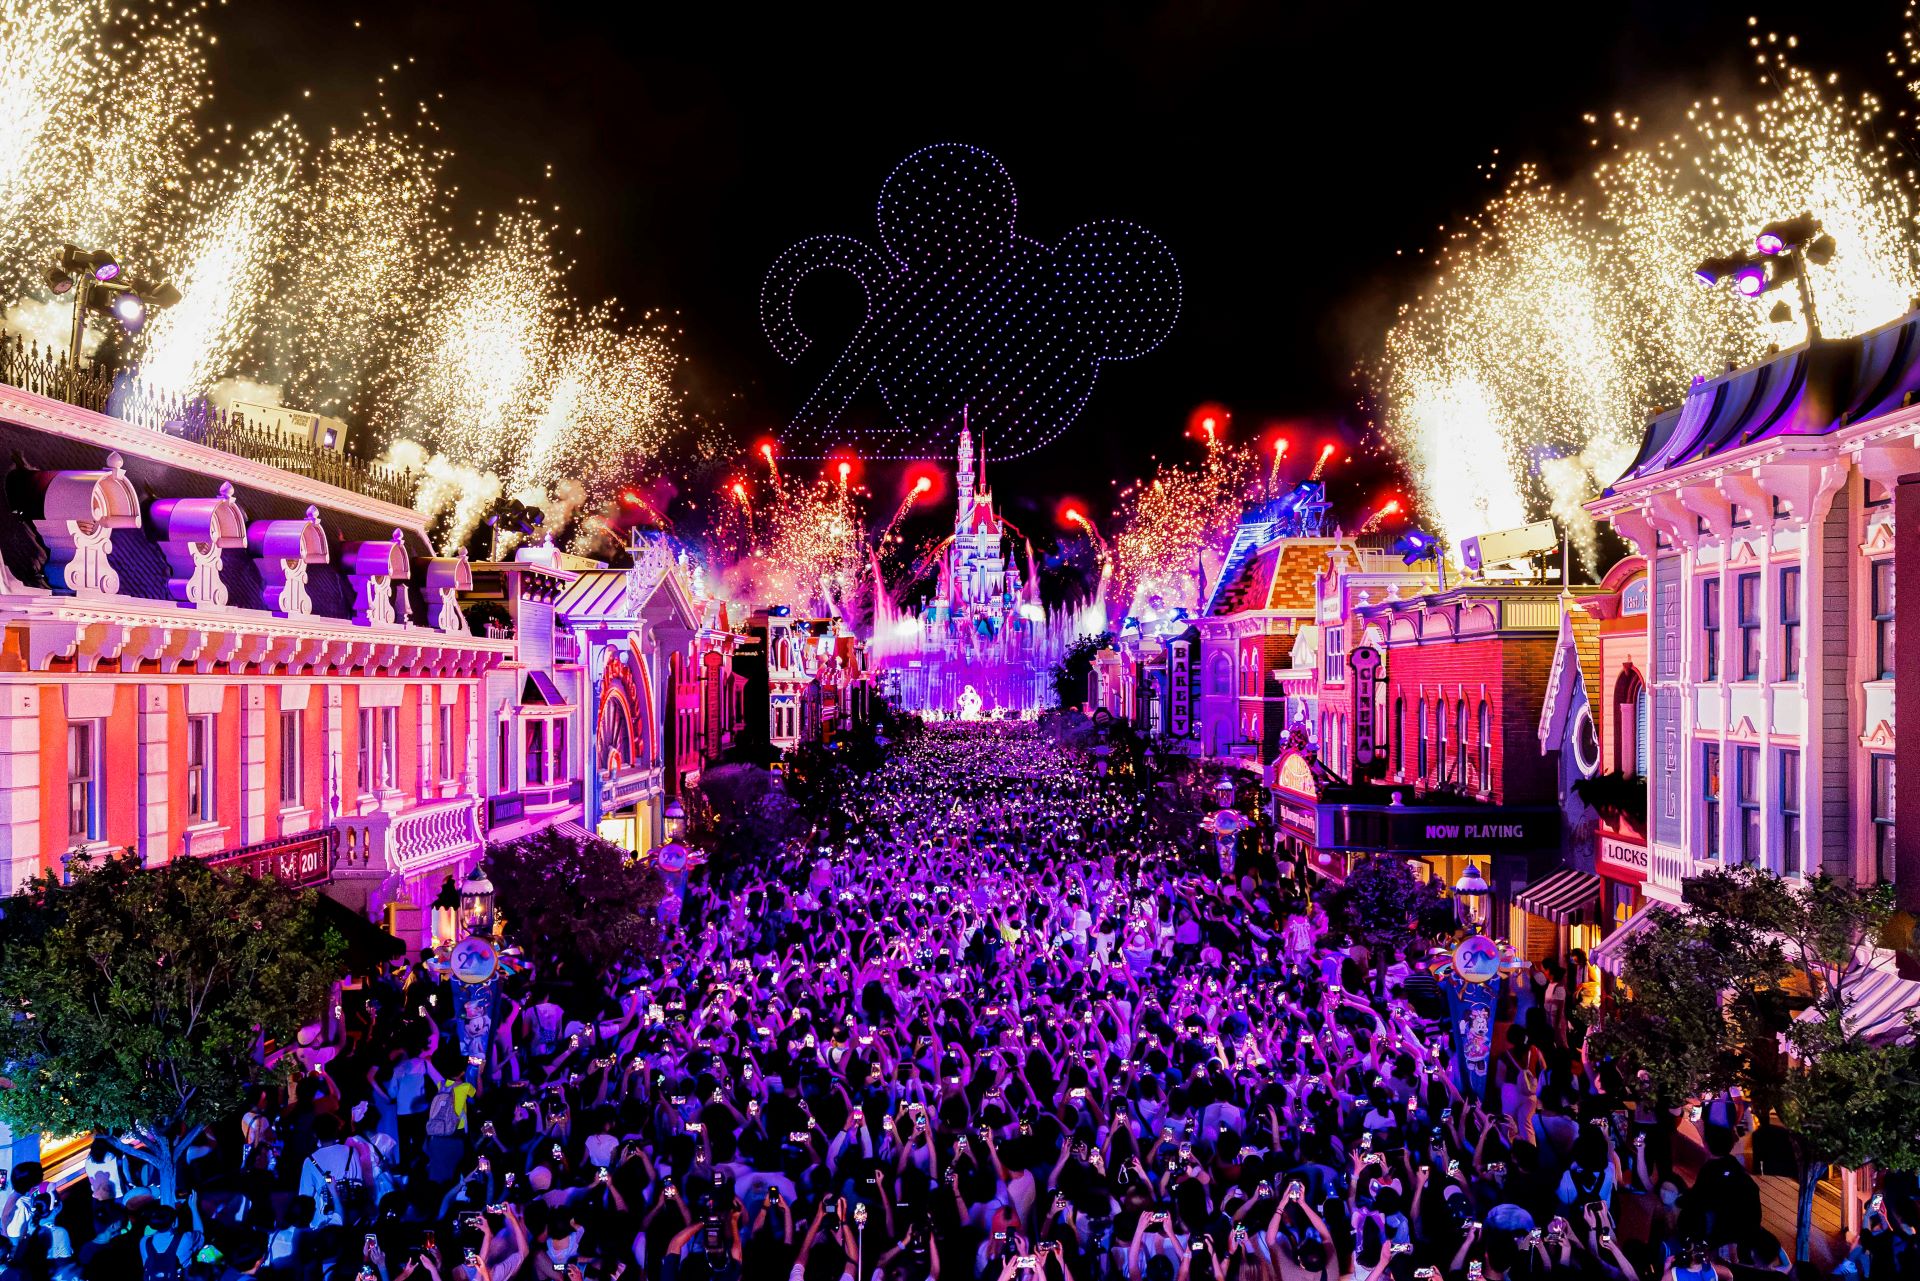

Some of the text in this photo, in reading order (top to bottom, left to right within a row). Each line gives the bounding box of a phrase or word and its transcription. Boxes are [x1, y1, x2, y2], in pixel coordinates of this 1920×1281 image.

[1174, 647, 1188, 731] BAKERY
[1358, 667, 1372, 751] CINEMA
[1425, 824, 1524, 839] NOW PLAYING
[1608, 843, 1648, 867] LOCKS
